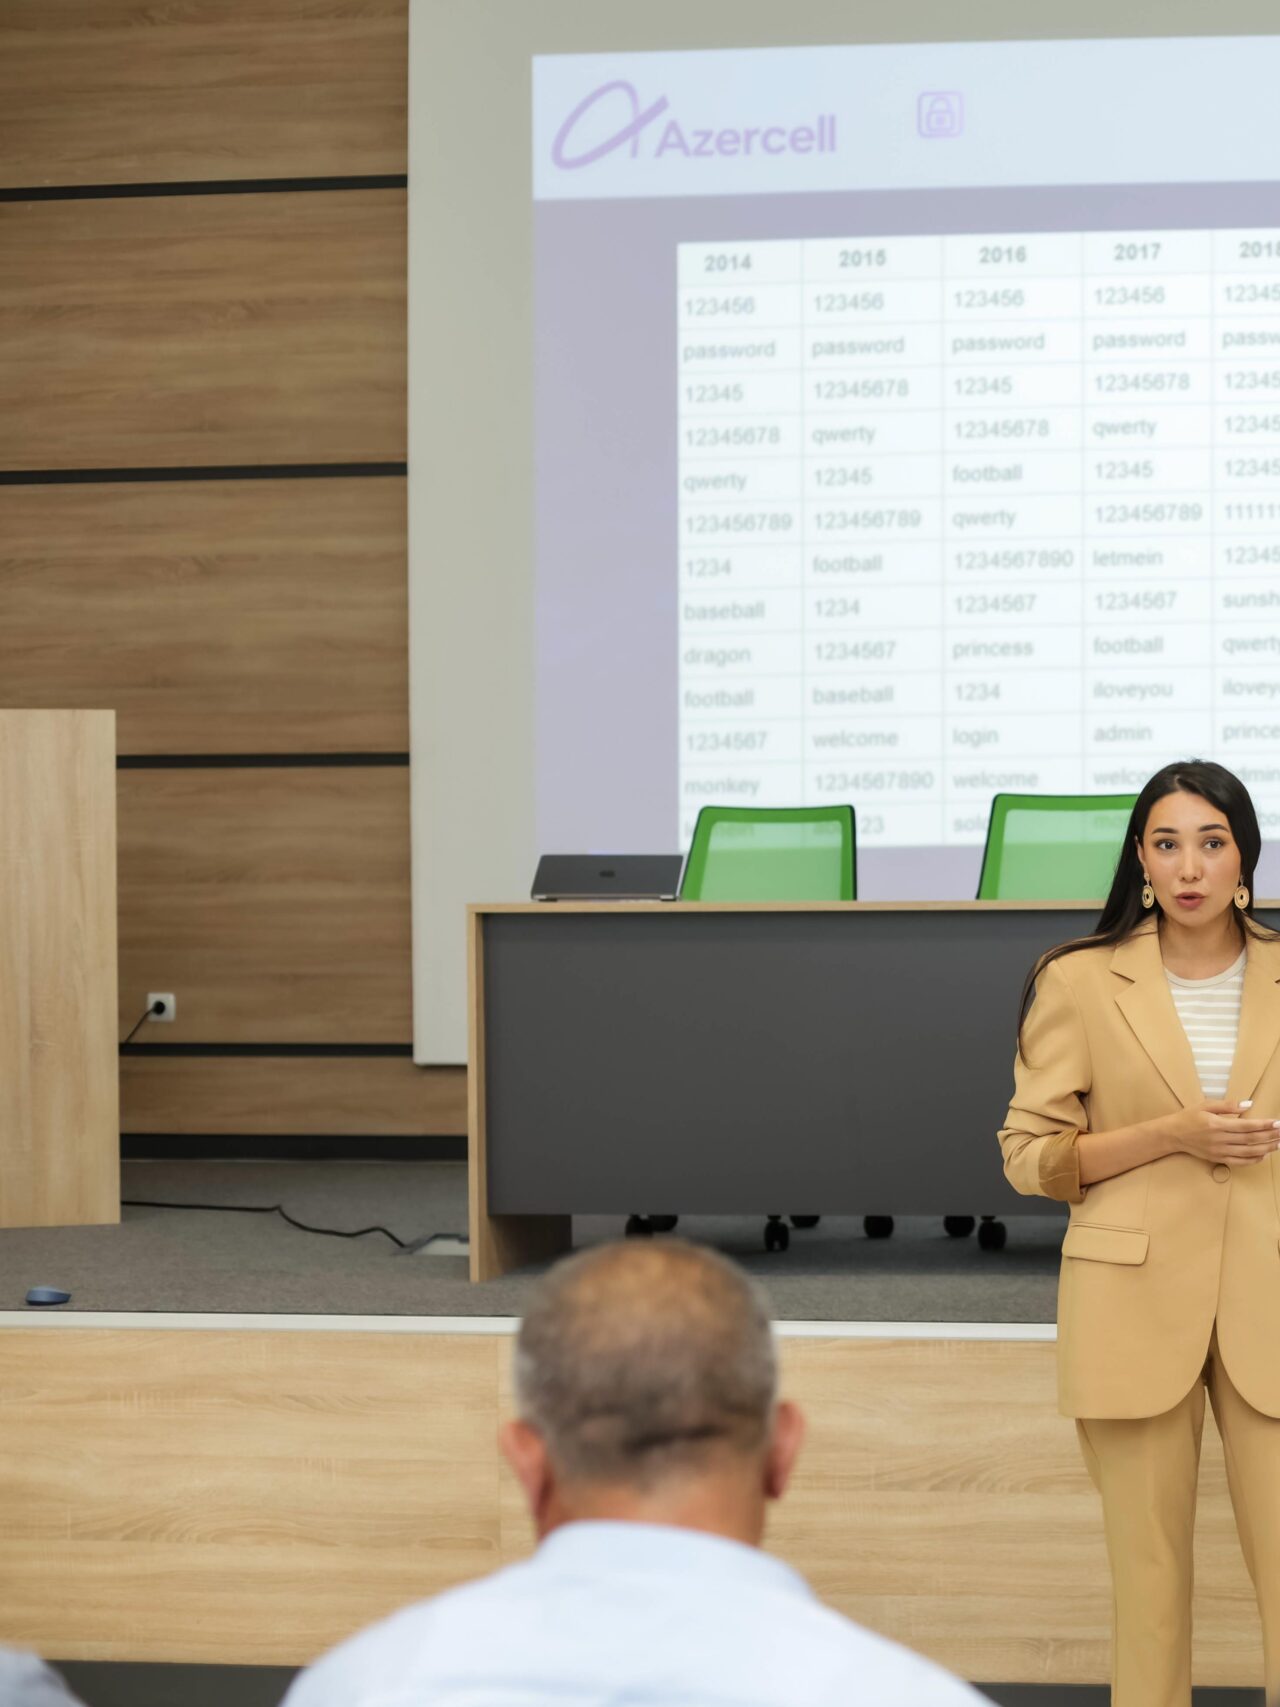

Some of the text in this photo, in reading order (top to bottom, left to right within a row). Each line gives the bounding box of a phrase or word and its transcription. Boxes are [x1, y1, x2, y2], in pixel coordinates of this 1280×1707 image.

[654, 115, 837, 158] Azercell
[839, 248, 887, 268] 2015
[979, 246, 1027, 264] 2016
[1114, 242, 1161, 261] 2017
[705, 254, 752, 272] 2014
[814, 292, 884, 312] 123456
[955, 289, 1025, 308] 123456
[1095, 286, 1165, 305] 123456
[686, 296, 756, 316] 123456
[812, 337, 905, 359] password
[952, 333, 1045, 354] password
[1092, 331, 1186, 351] password
[683, 341, 776, 363] password
[814, 378, 909, 399] 12345678
[954, 376, 1013, 395] 12345
[1095, 372, 1190, 392] 12345678
[686, 383, 744, 403] 12345
[686, 426, 781, 446] 12345678
[812, 426, 876, 445] qwerty
[955, 419, 1050, 439] 12345678
[1092, 419, 1156, 438] qwerty
[815, 466, 873, 487] 12345
[952, 464, 1023, 483] football
[1095, 460, 1154, 480] 12345
[683, 473, 747, 493] qwerty
[686, 513, 793, 533] 123456789
[815, 509, 922, 530] 123456789
[952, 509, 1016, 529] qwerty
[1096, 503, 1203, 523] 123456789
[686, 558, 732, 577] 1234
[812, 555, 883, 573] football
[955, 549, 1074, 570] 1234567890
[1093, 550, 1163, 567] letmein
[815, 598, 861, 618] 1234
[955, 593, 1037, 614] 1234567
[1095, 590, 1177, 611] 1234567
[684, 601, 765, 621] baseball
[815, 640, 897, 661] 1234567
[952, 642, 1034, 660] princess
[1093, 636, 1164, 654] football
[683, 648, 751, 668] dragon
[684, 689, 754, 708] football
[812, 686, 894, 705] baseball
[955, 682, 1001, 701] 1234
[1093, 681, 1173, 700] iloveyou
[687, 731, 768, 752] 1234567
[813, 730, 899, 748] welcome
[953, 728, 999, 749] login
[1093, 725, 1153, 742] admin
[685, 777, 760, 796] monkey
[814, 771, 934, 792] 1234567890
[953, 771, 1039, 789] welcome
[1093, 768, 1147, 786] welco
